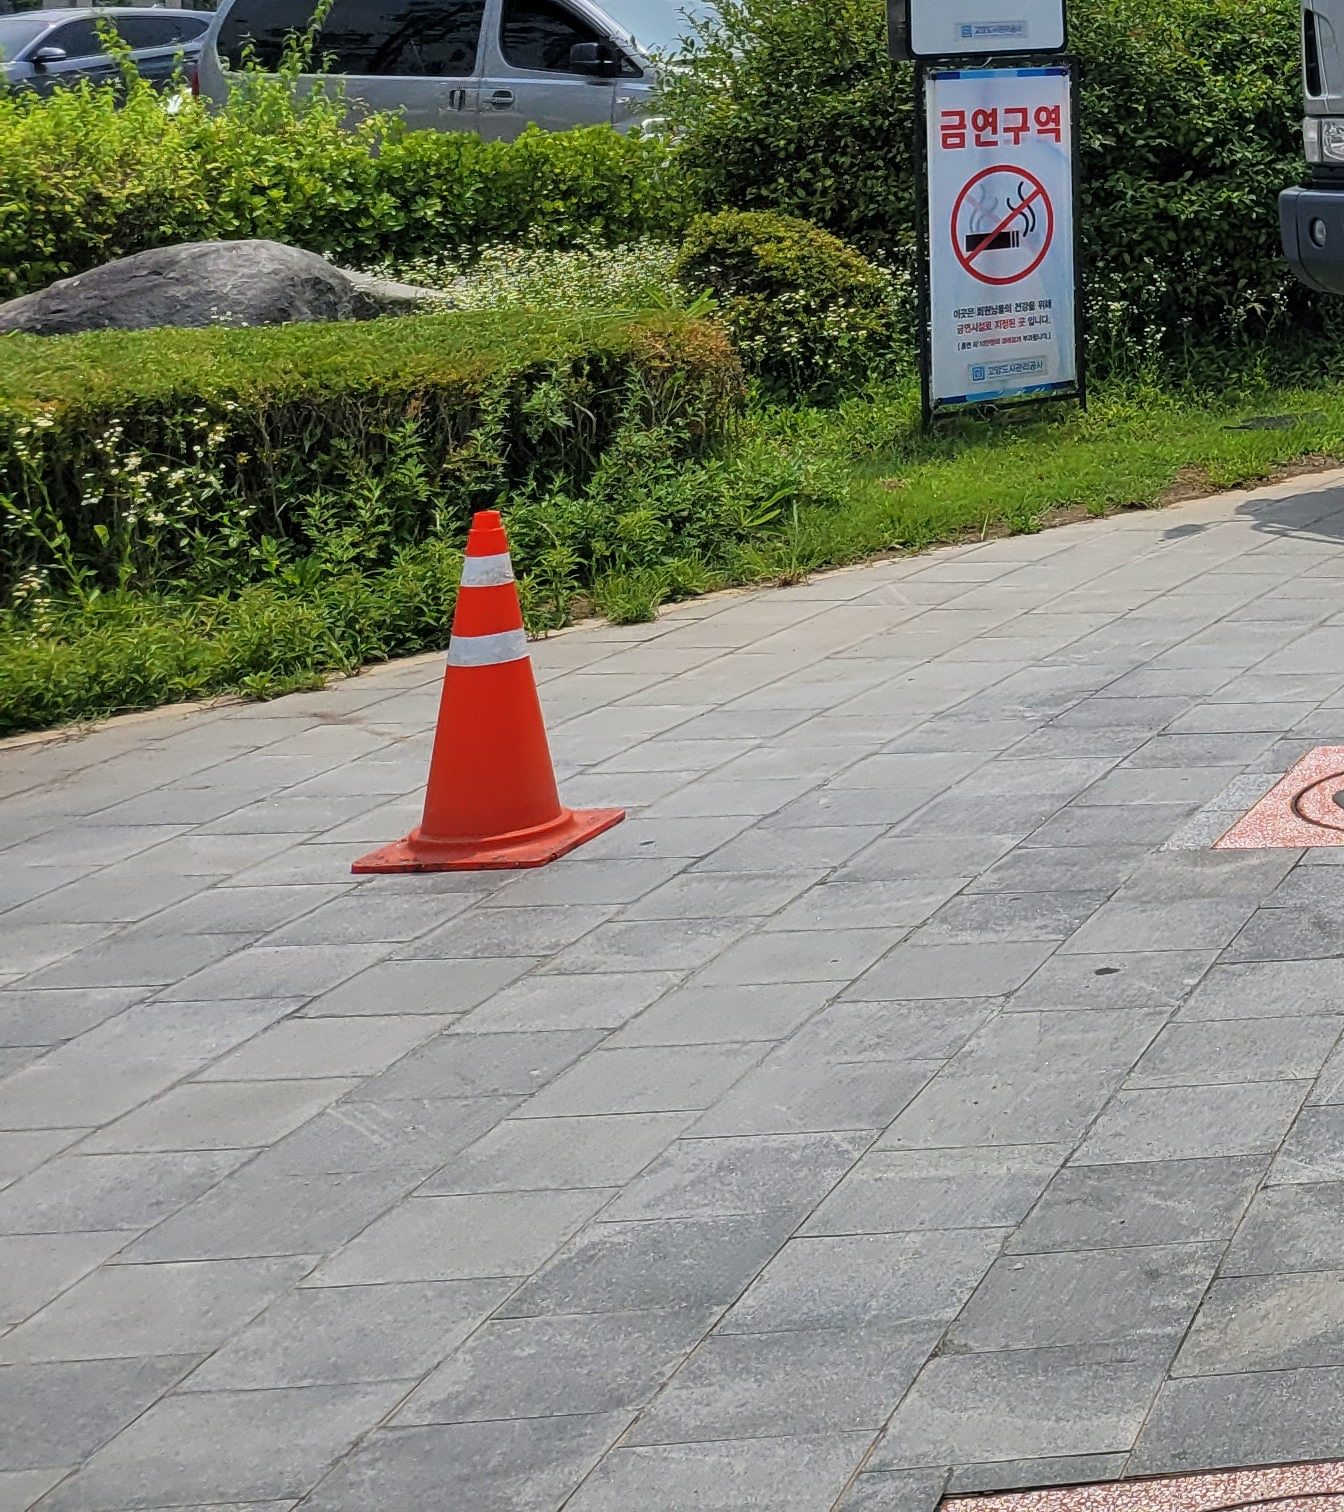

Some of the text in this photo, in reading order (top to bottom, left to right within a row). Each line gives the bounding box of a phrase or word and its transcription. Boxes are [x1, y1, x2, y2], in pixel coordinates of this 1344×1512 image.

[940, 104, 1062, 149] 금연구역
[953, 307, 976, 320] 이곳은
[1014, 300, 1036, 313] 건강을
